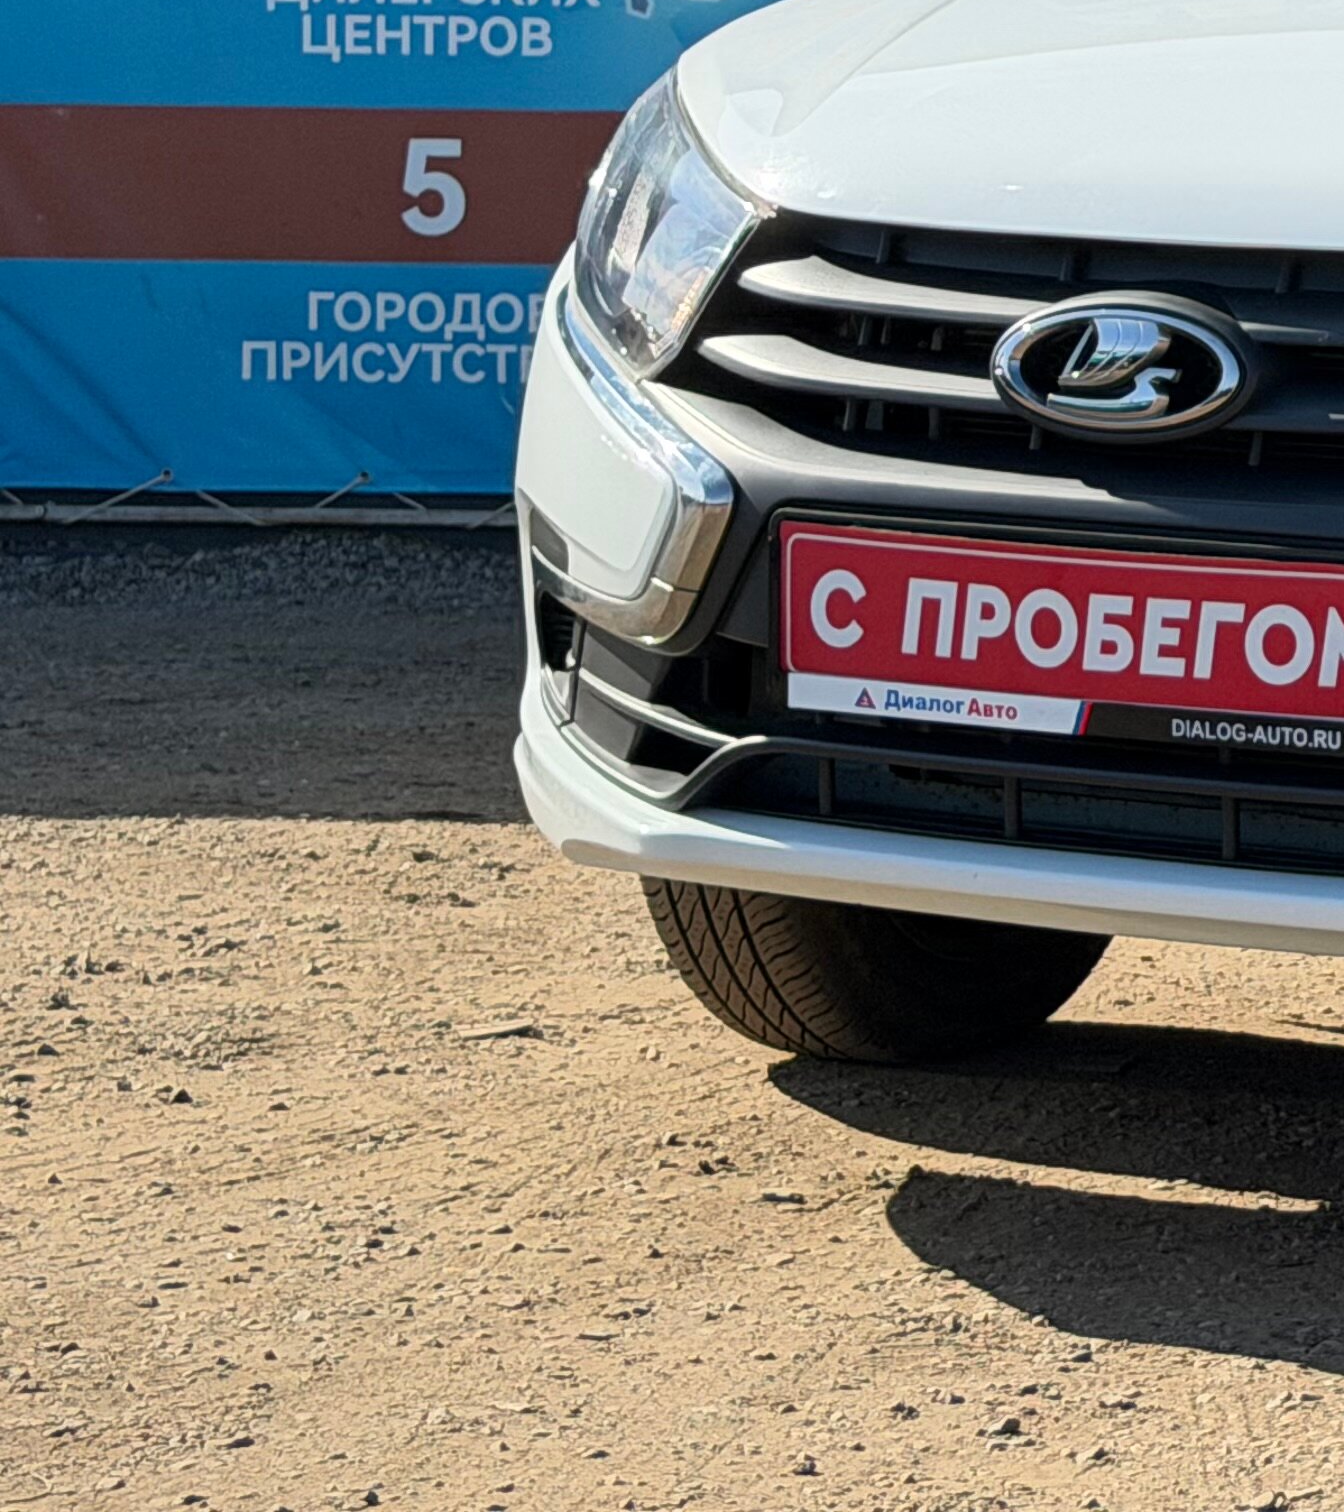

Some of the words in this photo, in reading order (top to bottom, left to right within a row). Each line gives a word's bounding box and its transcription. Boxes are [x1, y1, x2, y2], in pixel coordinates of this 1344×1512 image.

[301, 15, 552, 63] ЦЕНТРОВ
[401, 139, 467, 238] 5
[241, 340, 535, 384] ПРИСУТСТ
[811, 569, 866, 648] С
[1172, 718, 1341, 750] DIALOG-AUTO.RU
